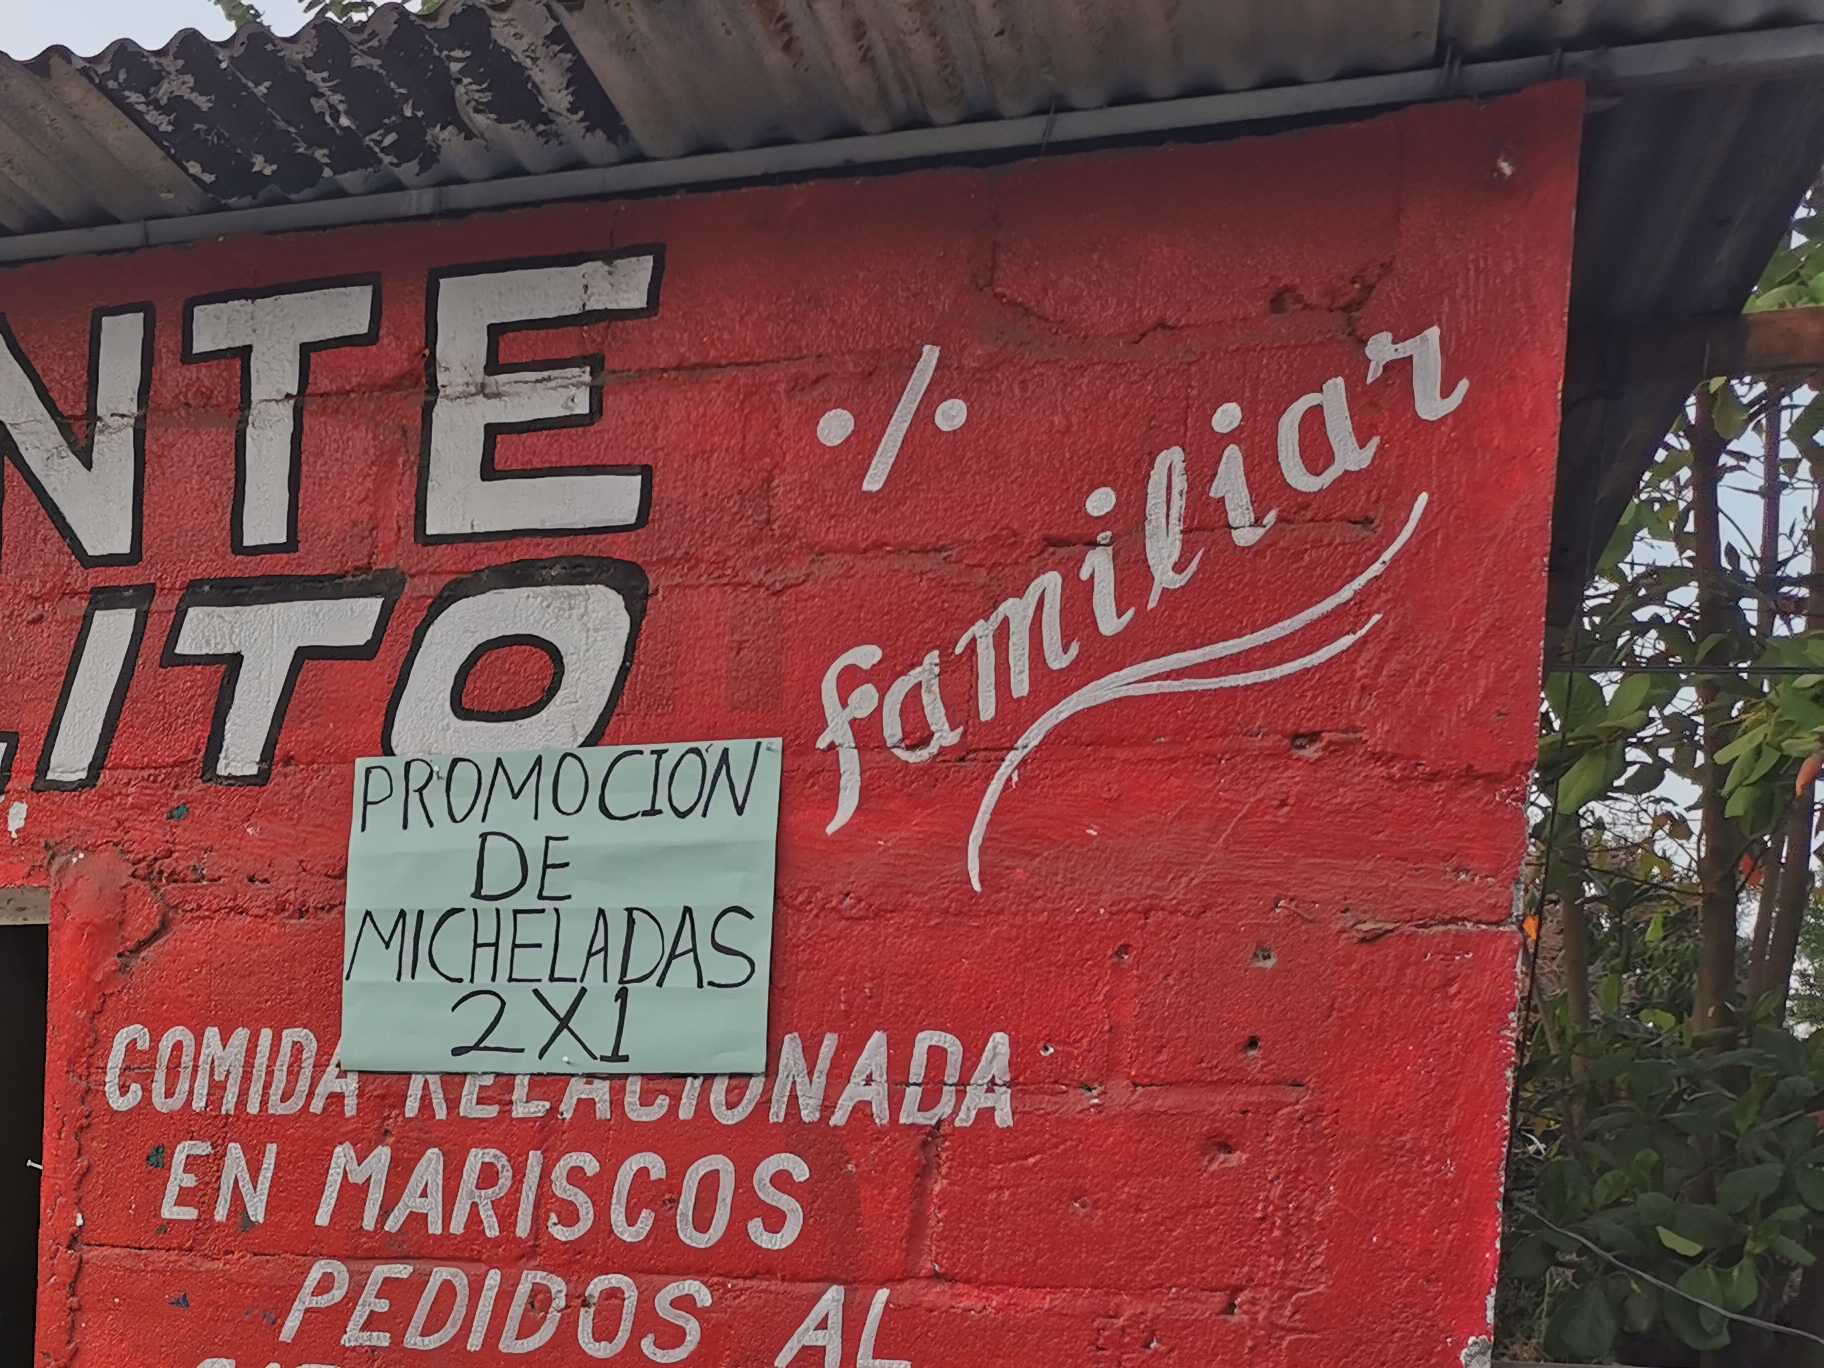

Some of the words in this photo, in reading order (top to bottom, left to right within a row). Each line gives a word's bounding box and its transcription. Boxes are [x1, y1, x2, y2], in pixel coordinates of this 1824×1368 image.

[814, 325, 1470, 836] familiar
[470, 830, 573, 902] DE
[344, 904, 757, 989] MICHELADAS
[104, 1022, 360, 1119] COMIDA
[160, 1139, 278, 1224] EN
[314, 1142, 811, 1250] MARISCOS
[279, 1259, 714, 1364] PEDIDOS
